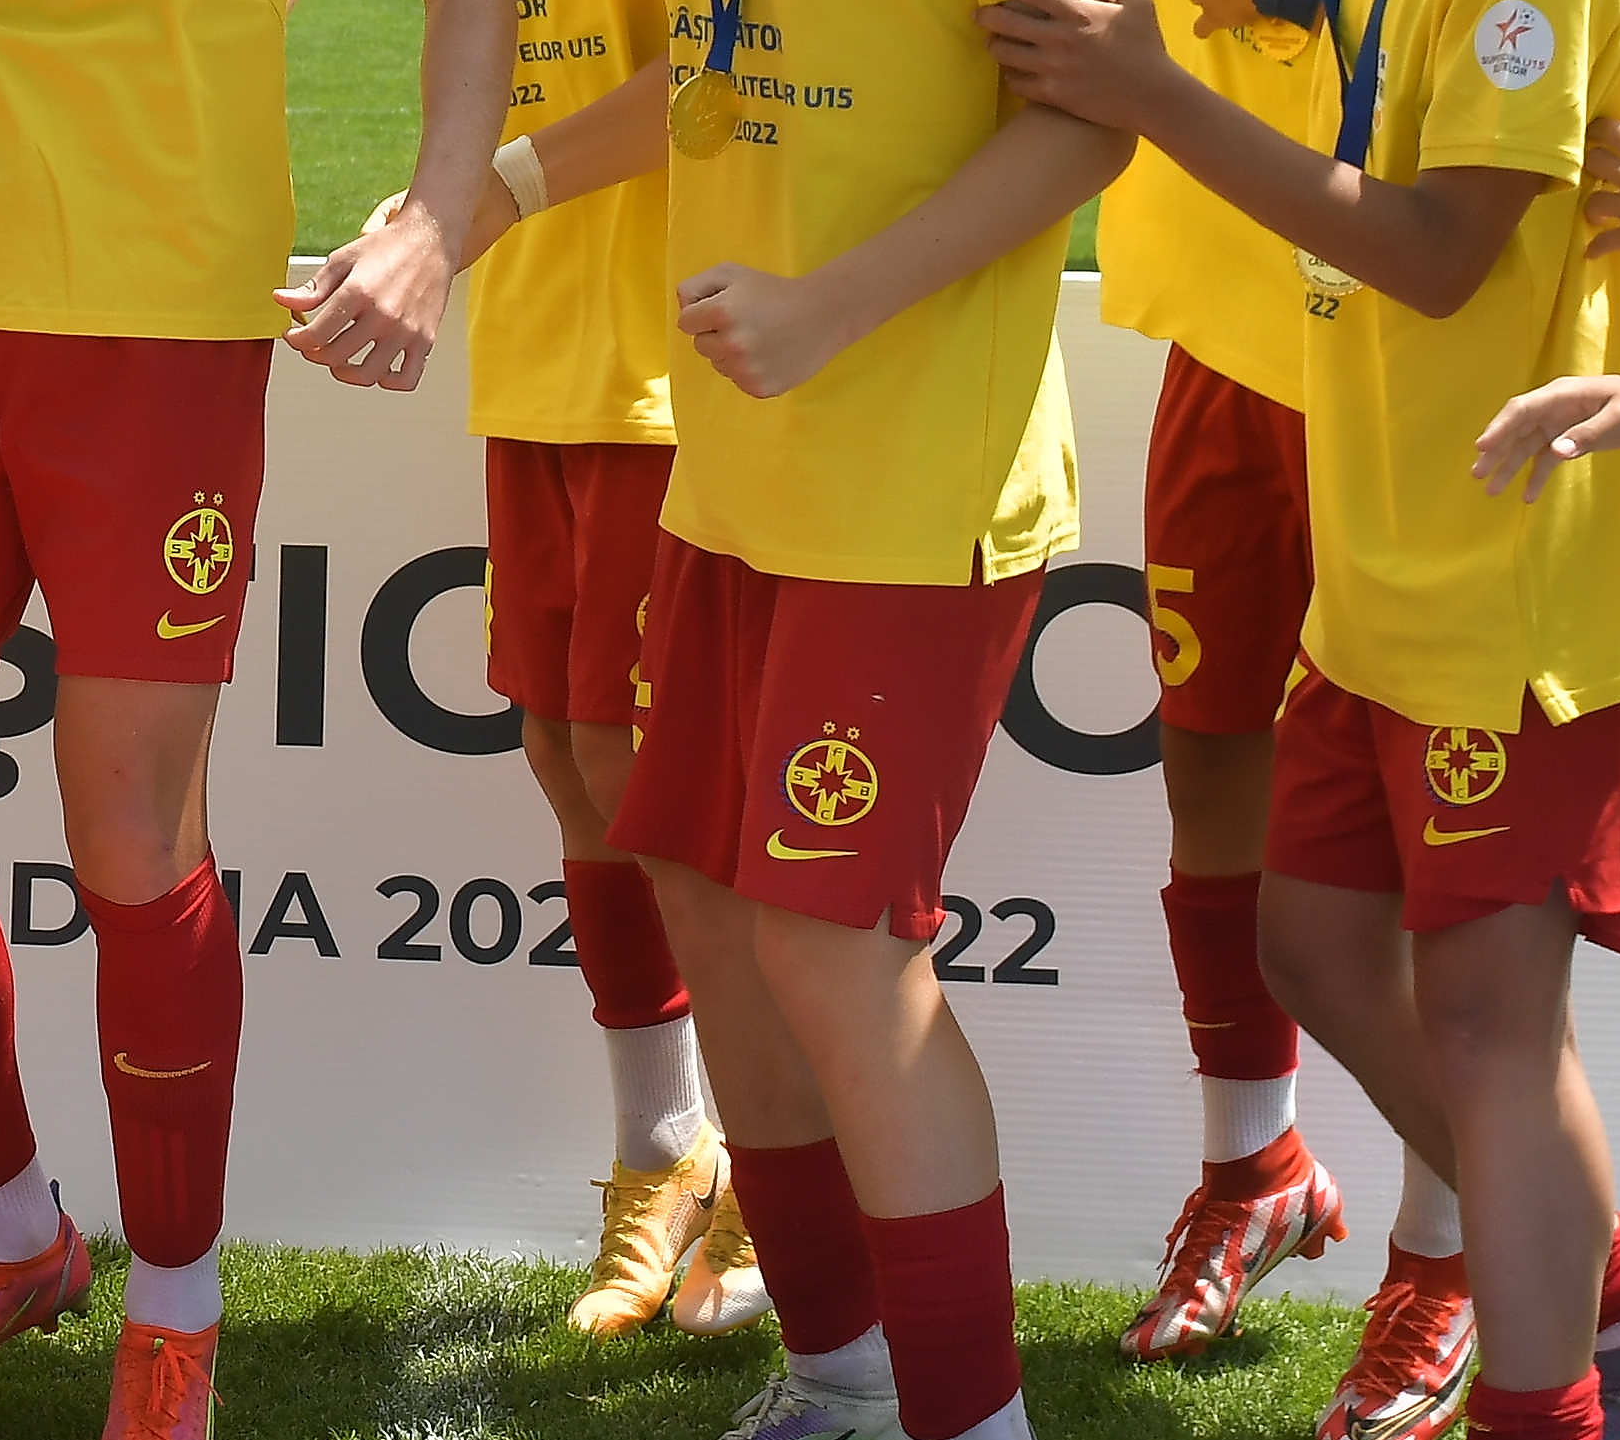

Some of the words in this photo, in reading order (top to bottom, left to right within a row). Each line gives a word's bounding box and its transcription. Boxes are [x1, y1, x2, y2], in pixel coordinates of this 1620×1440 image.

[567, 35, 607, 59] U15
[804, 86, 854, 110] U15
[1146, 562, 1203, 687] 5
